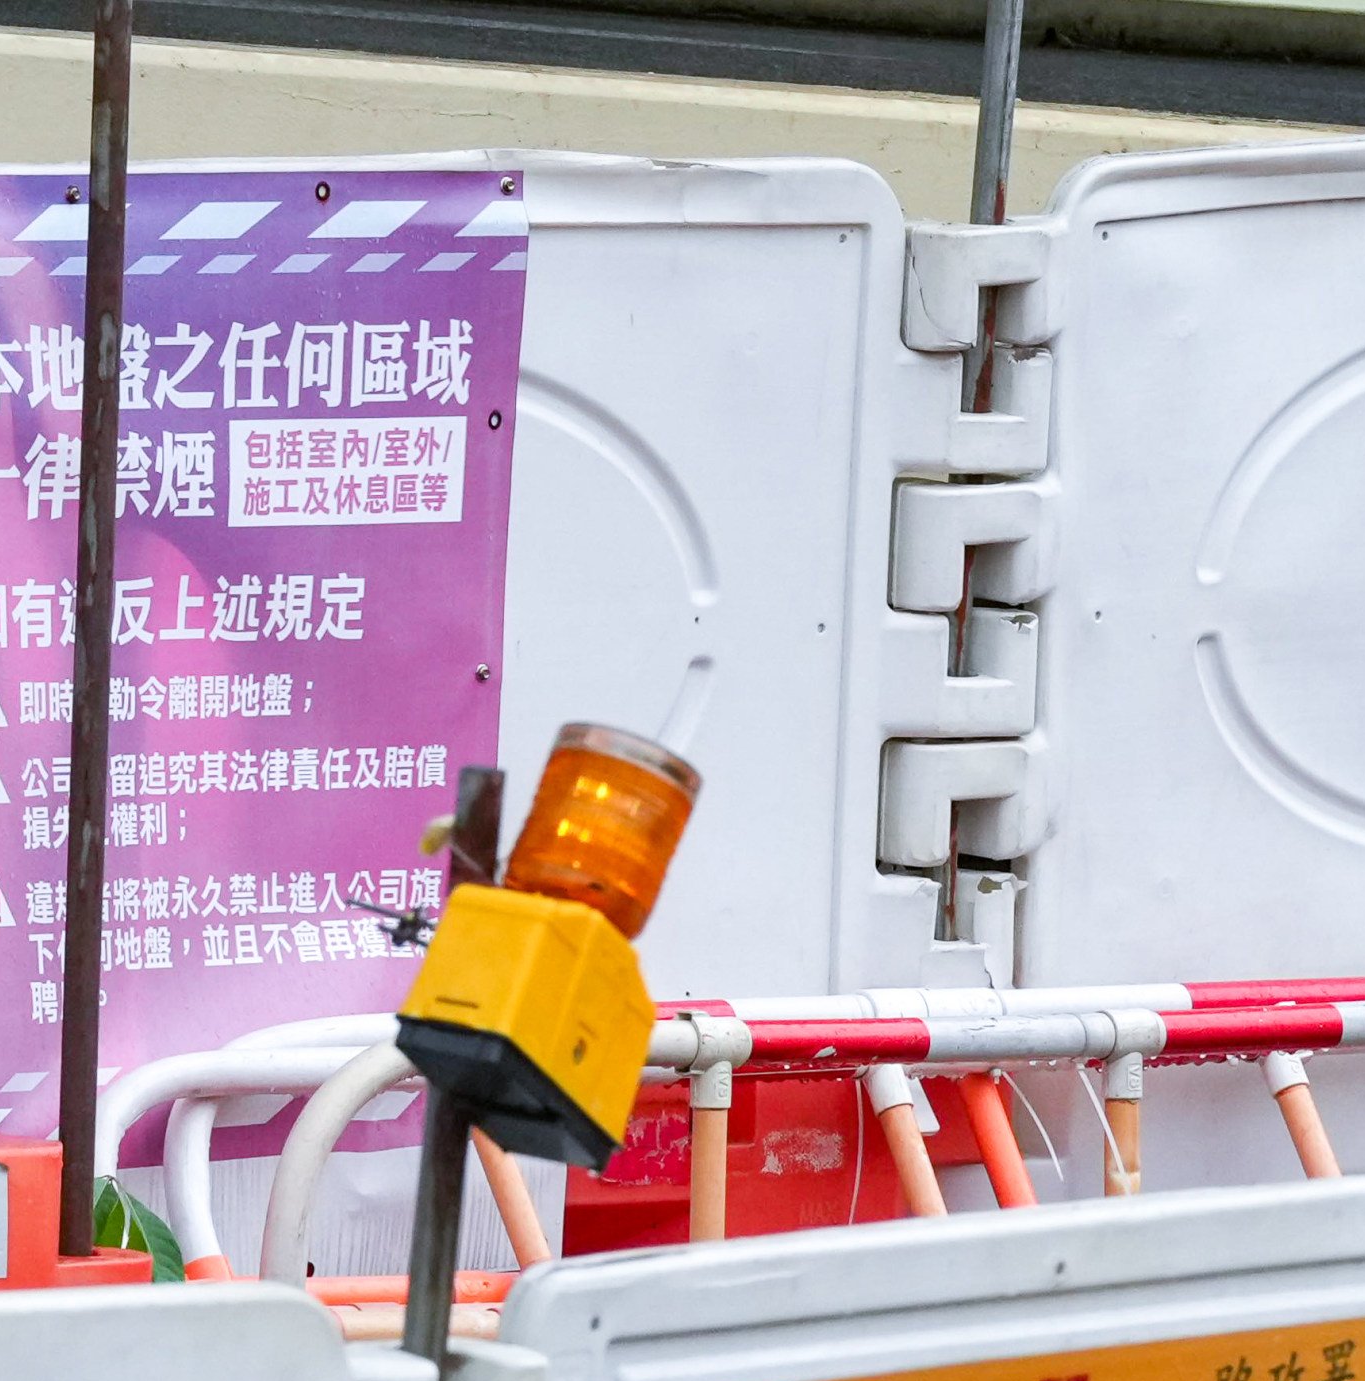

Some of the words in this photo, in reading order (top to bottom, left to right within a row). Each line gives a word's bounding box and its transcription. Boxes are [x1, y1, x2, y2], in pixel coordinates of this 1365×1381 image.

[242, 473, 450, 517] 施工及休息區等
[19, 673, 314, 725] 即時勒令離開地盤；
[21, 744, 448, 800] 公司留追究其法律責任及賠償
